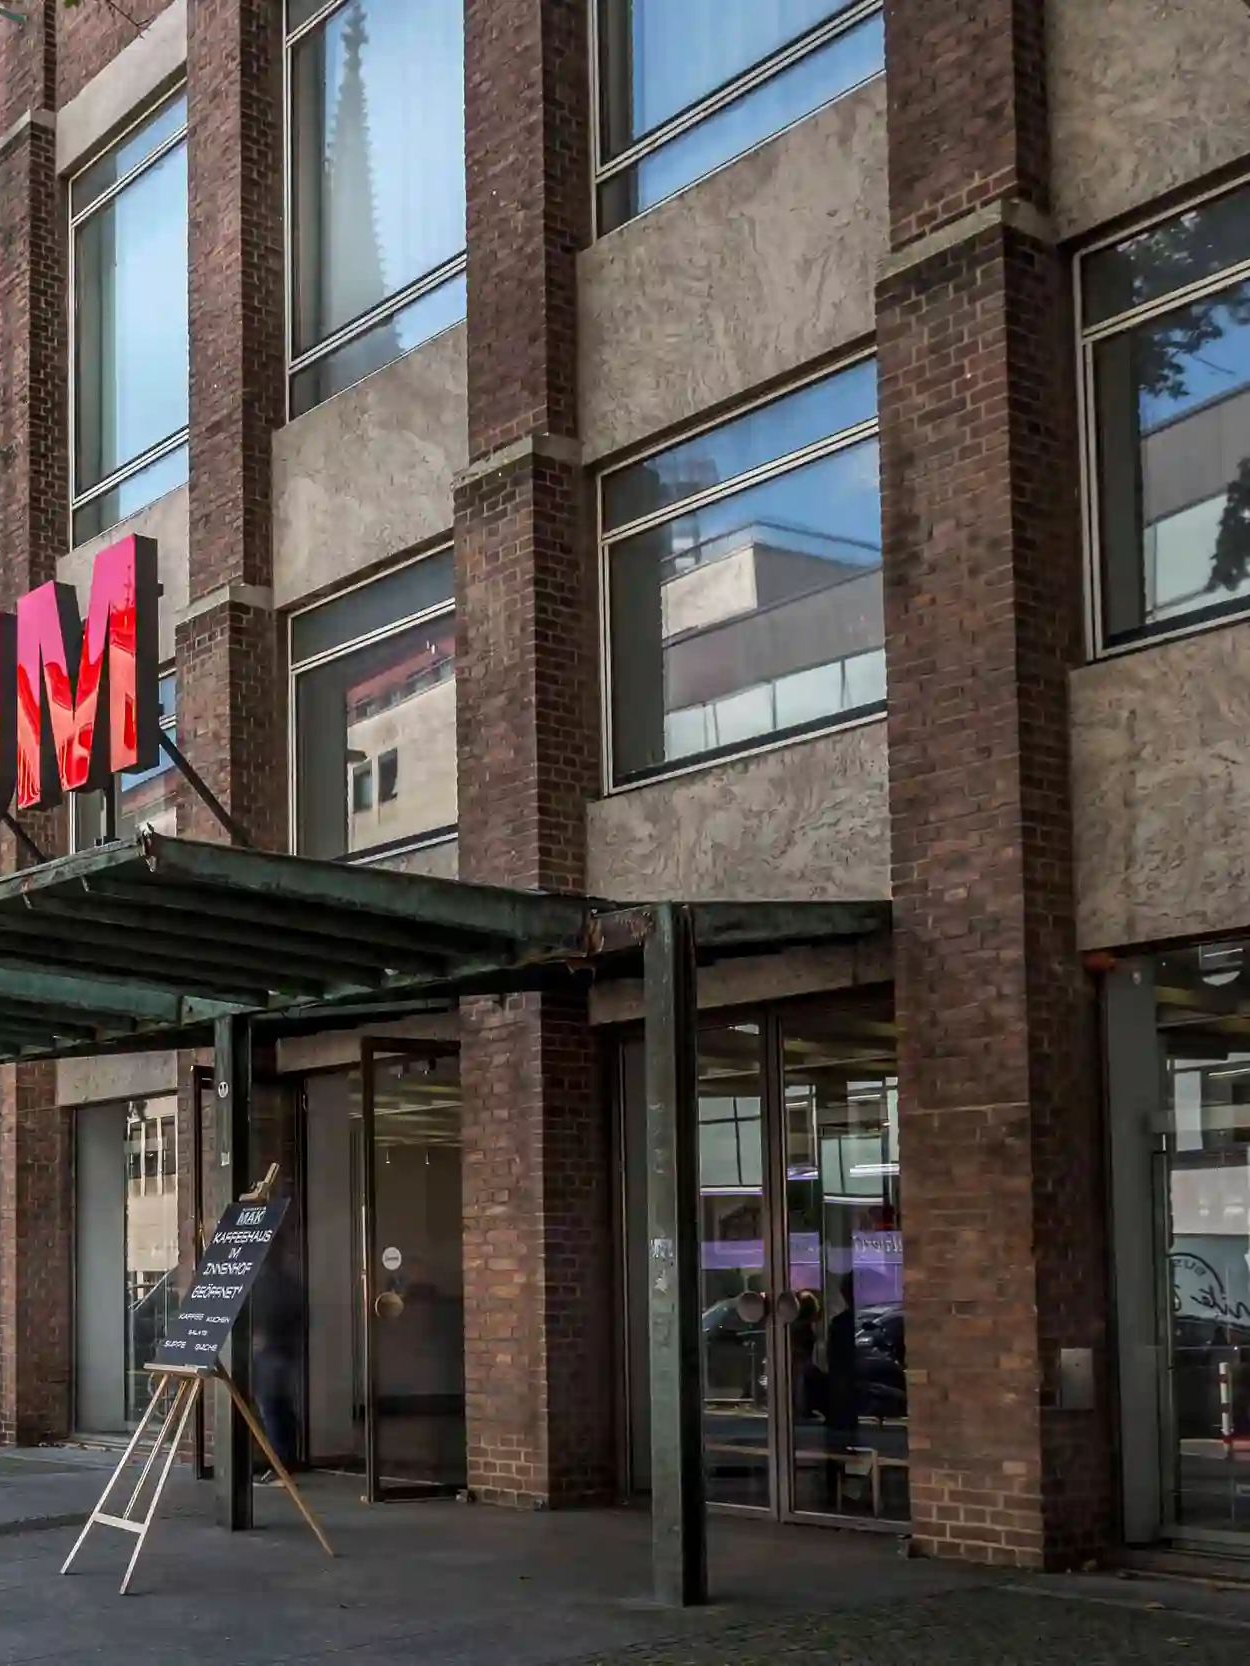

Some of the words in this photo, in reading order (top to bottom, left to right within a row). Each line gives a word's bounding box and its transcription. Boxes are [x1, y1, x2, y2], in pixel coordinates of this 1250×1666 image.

[236, 1210, 266, 1226] MAK
[213, 1230, 272, 1243] KAFFEEHAUS
[228, 1246, 242, 1259] IM
[203, 1262, 253, 1276] INNENHOF
[178, 1313, 205, 1321] KAFFEE
[164, 1340, 187, 1349] SUPPE
[194, 1343, 218, 1352] QUICHE
